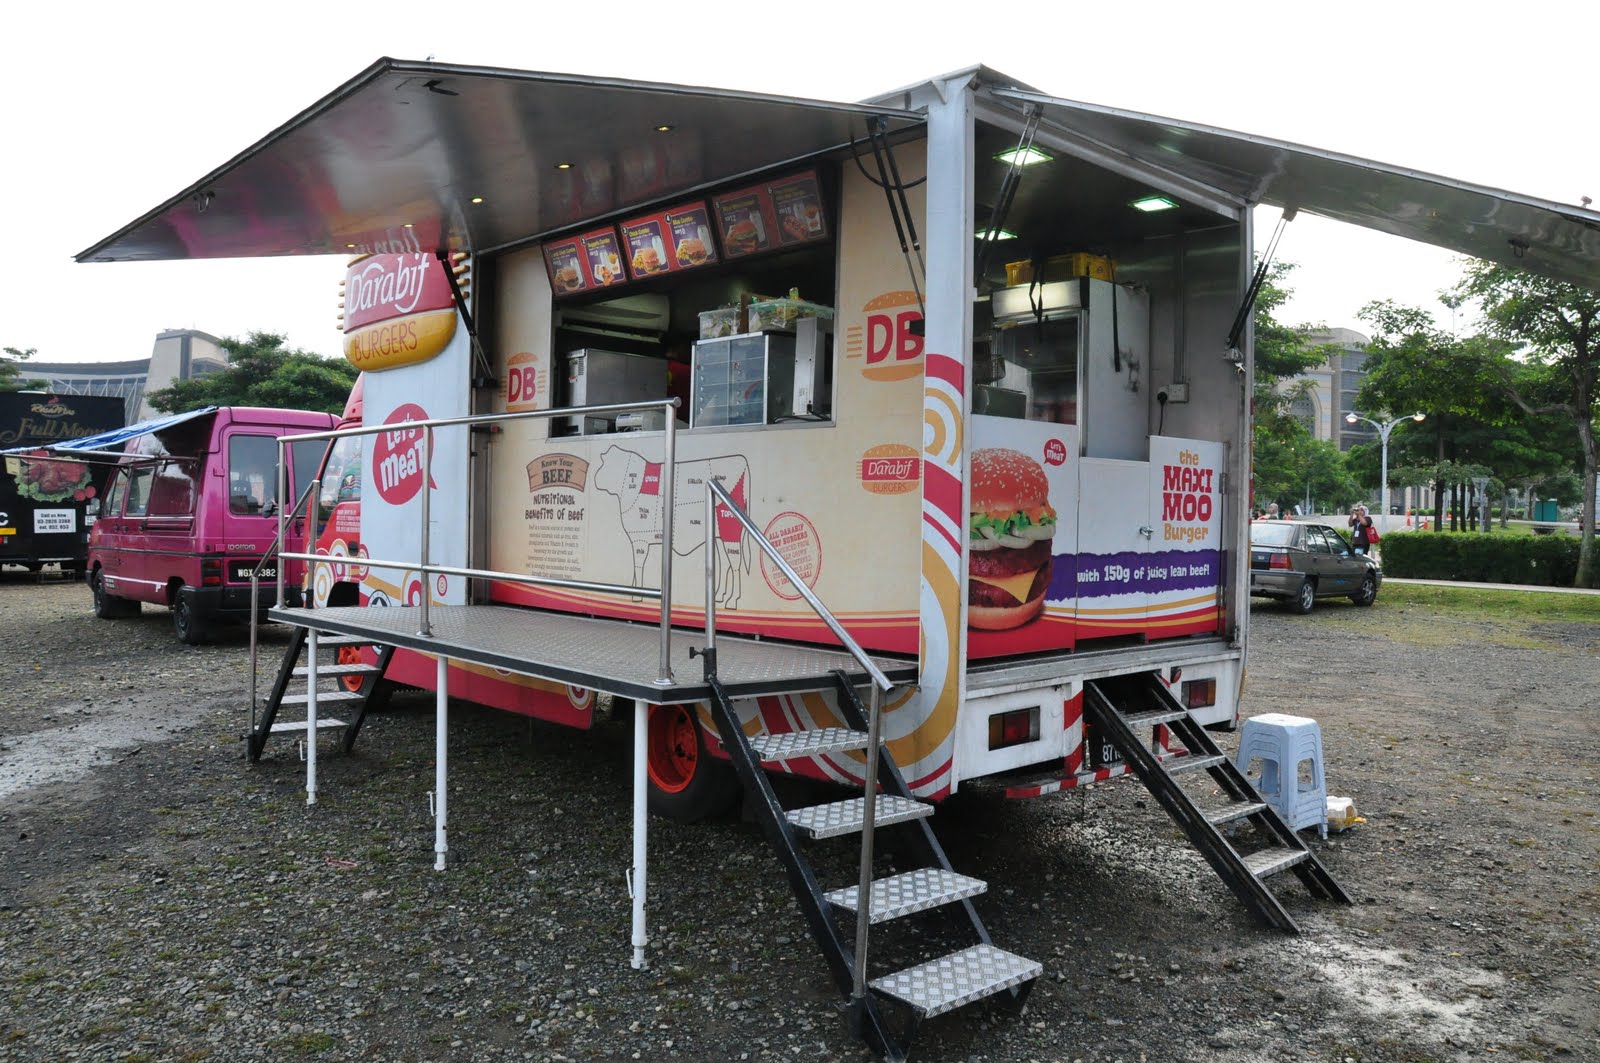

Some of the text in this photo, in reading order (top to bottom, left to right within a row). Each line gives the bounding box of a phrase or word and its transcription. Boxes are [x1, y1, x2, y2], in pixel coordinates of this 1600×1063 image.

[349, 253, 429, 315] Darabif
[354, 320, 417, 362] BURGERS
[866, 311, 925, 365] DB
[507, 367, 536, 402] DB
[541, 458, 574, 468] Know Your
[1179, 449, 1199, 465] the
[542, 468, 573, 484] BEEF
[868, 460, 914, 480] Darabif
[1163, 465, 1213, 493] MAXI
[1162, 492, 1212, 521] MOO
[769, 532, 779, 540] ALL
[783, 531, 808, 545] BURGERS
[1164, 523, 1209, 543] Burger
[257, 569, 276, 577] 382
[1077, 564, 1210, 583] with 150g of juicy lean beef!
